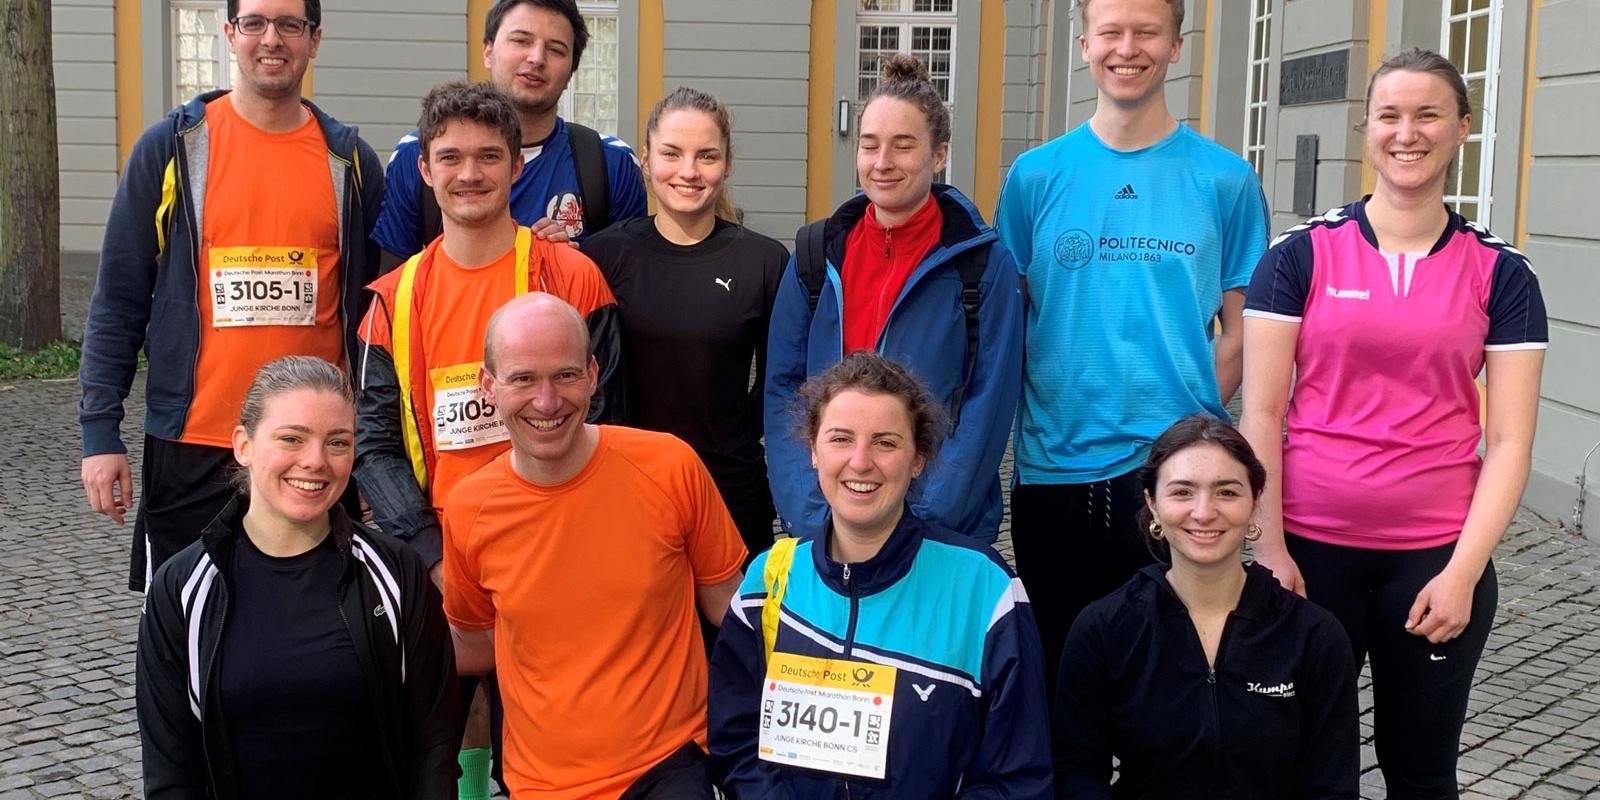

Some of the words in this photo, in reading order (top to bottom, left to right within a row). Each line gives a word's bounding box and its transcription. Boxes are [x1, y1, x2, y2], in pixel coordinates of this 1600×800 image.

[1099, 236, 1196, 255] POLITECNICO
[223, 254, 263, 263] Deutsche
[265, 254, 285, 263] Post
[1099, 252, 1137, 262] MILANO
[1138, 253, 1162, 263] 1863
[230, 280, 300, 301] 3105-1
[1325, 283, 1371, 301] hummel
[255, 304, 280, 312] KIRCHE
[281, 304, 301, 312] BONN
[445, 373, 477, 383] Deutsche
[446, 397, 496, 423] 3105
[449, 426, 473, 435] JUNGE
[473, 421, 499, 432] KIRCHE
[780, 664, 821, 679] Deutsche
[823, 670, 847, 682] Post
[776, 699, 862, 738] 3140-1
[774, 734, 795, 744] JUNGE
[795, 737, 822, 748] KIRCHE
[823, 741, 846, 752] BONN
